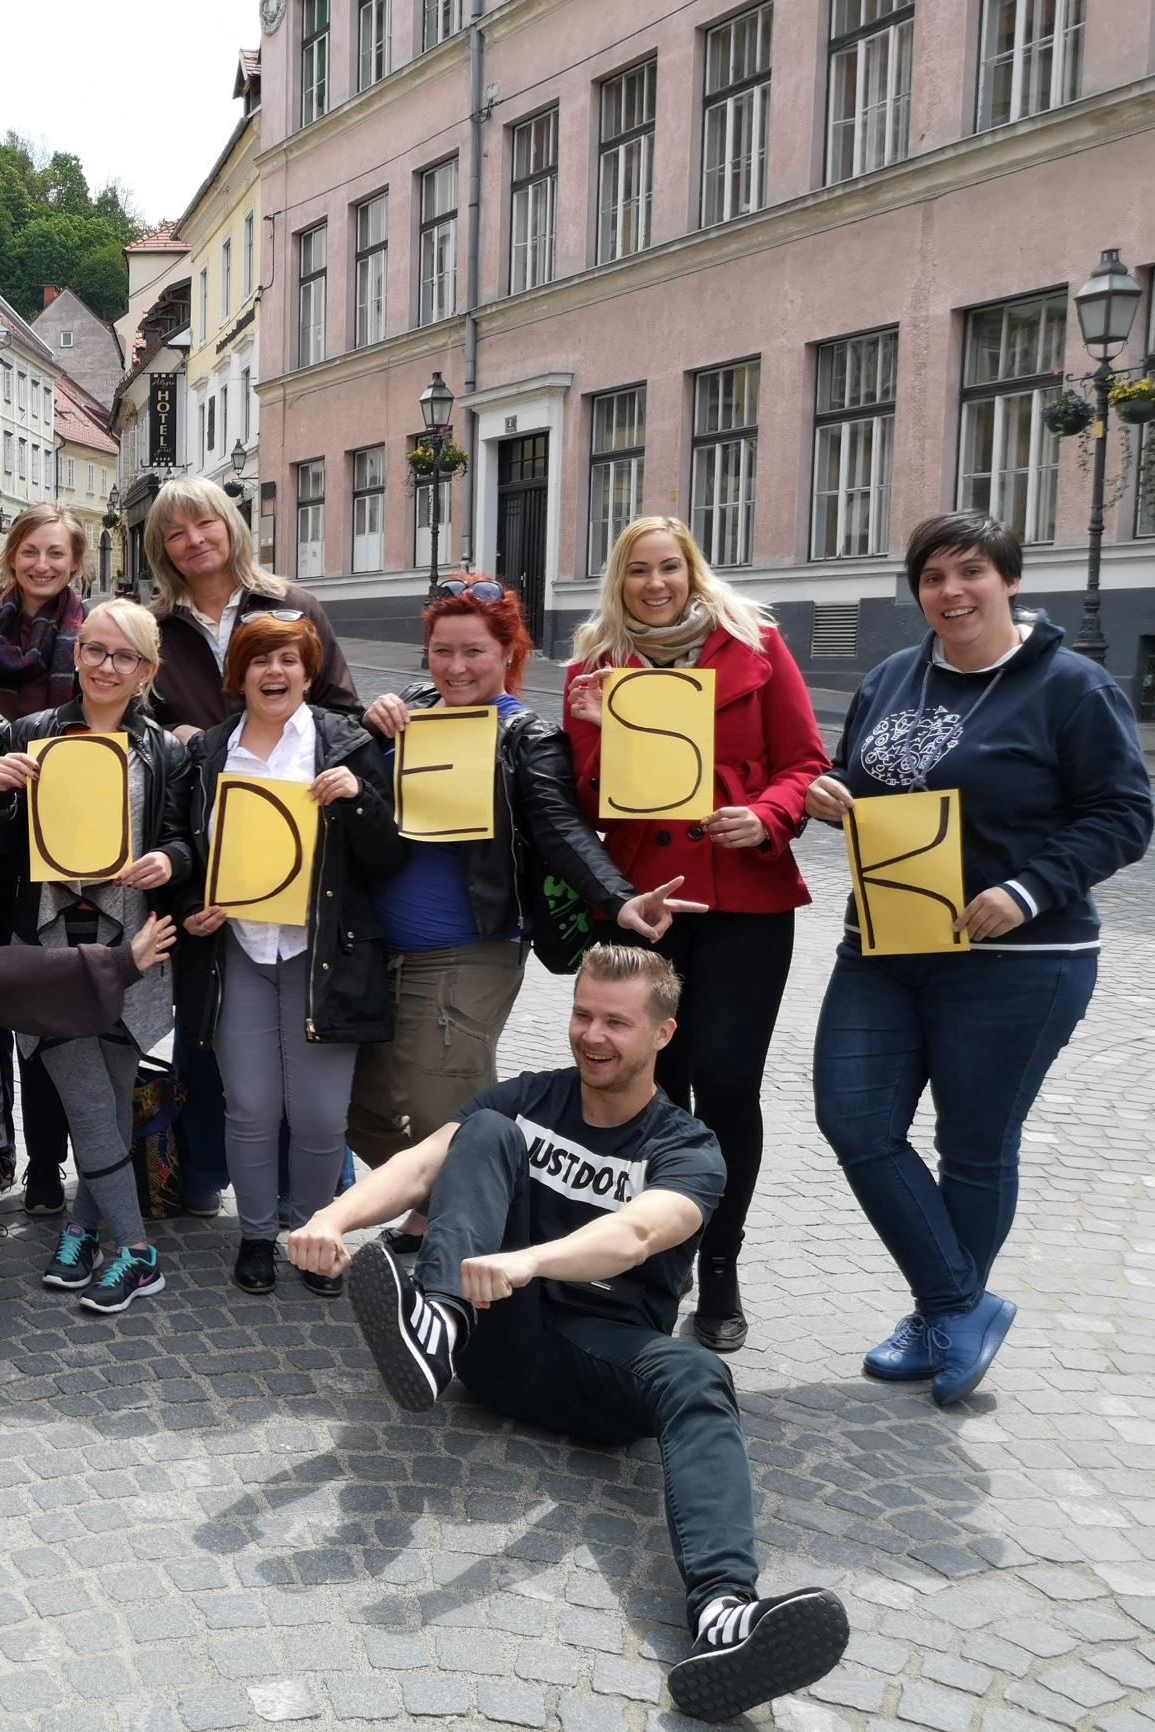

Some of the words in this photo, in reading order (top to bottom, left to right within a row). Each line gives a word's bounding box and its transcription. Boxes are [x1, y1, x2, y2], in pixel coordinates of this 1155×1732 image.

[156, 390, 170, 446] HOTEL
[398, 709, 490, 836] E
[607, 669, 703, 814] S
[208, 780, 303, 907] D
[848, 795, 961, 950] K
